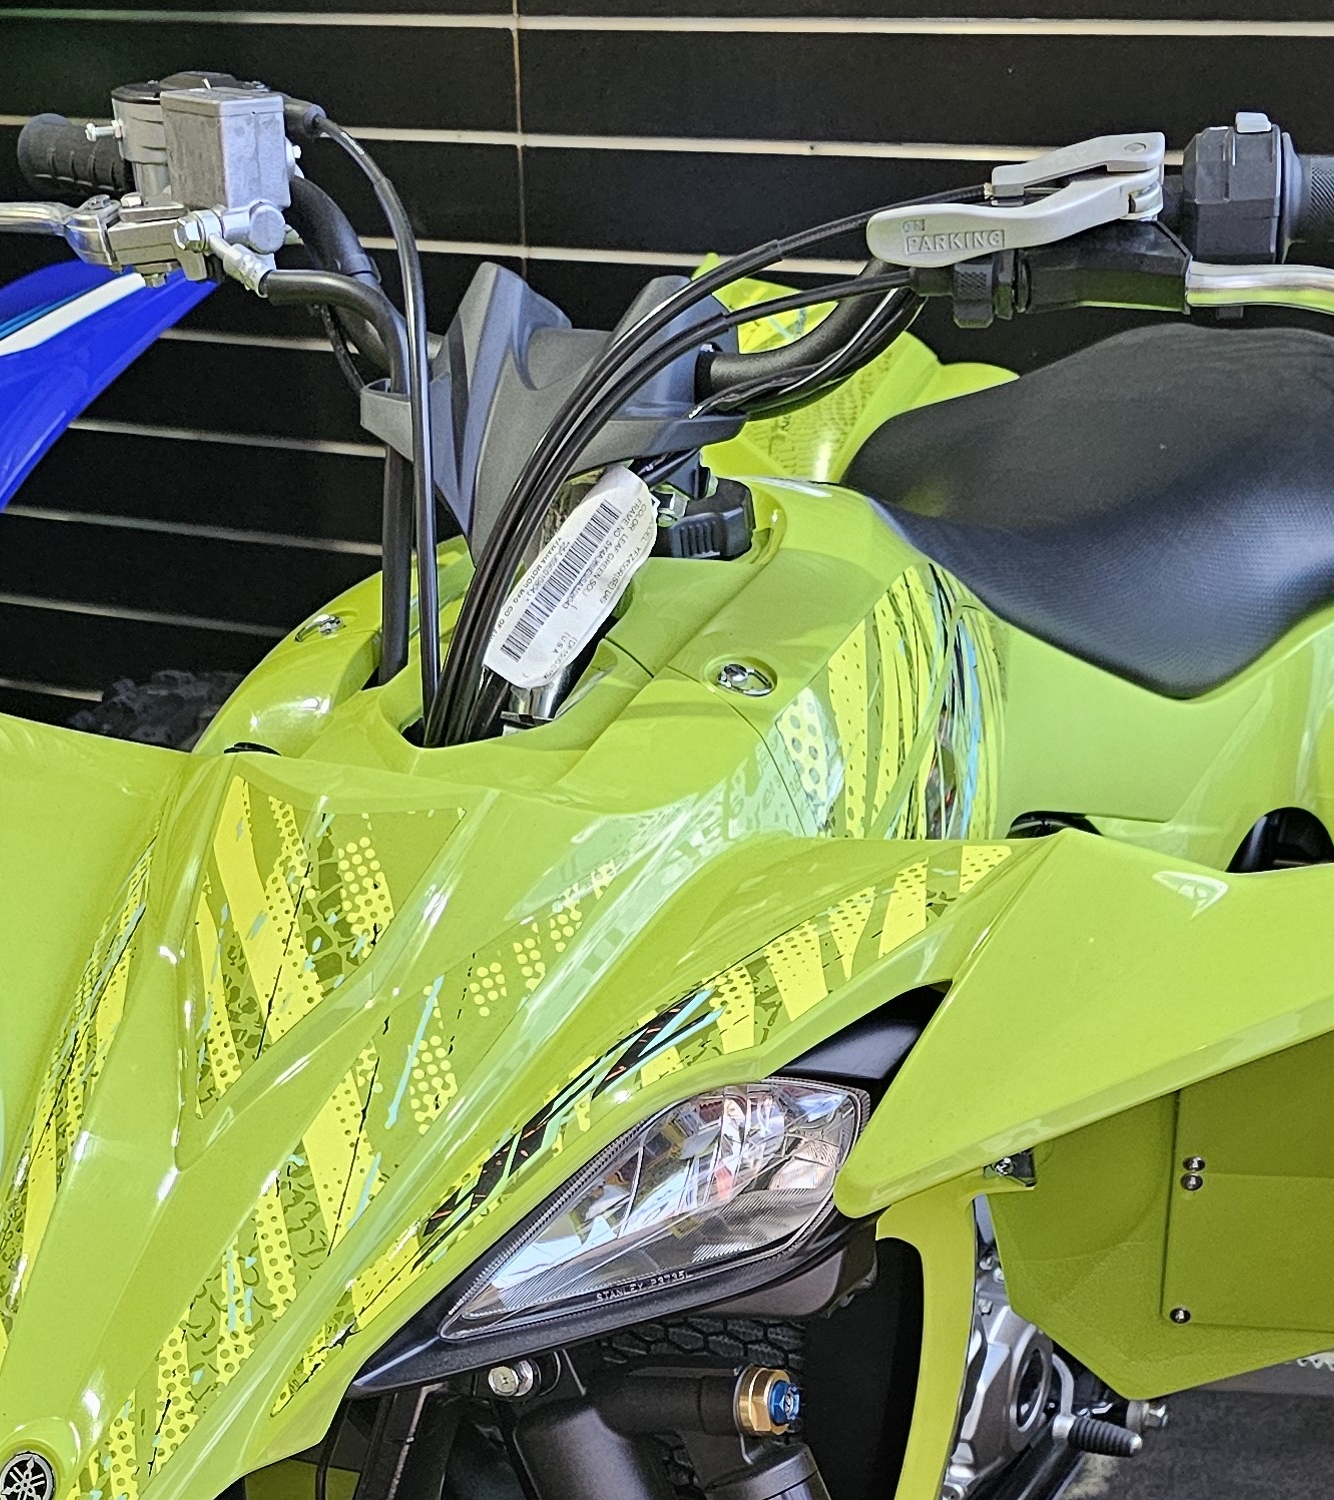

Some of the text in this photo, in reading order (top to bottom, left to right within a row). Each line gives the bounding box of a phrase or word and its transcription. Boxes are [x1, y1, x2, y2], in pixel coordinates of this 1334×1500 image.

[907, 229, 1005, 253] PARKING
[620, 497, 642, 525] FRAME
[627, 503, 648, 531] COLOR
[539, 535, 561, 564] YAMAHA
[611, 533, 628, 554] LEAF
[593, 551, 615, 580] GREEN
[596, 1281, 644, 1303] STANLEY
